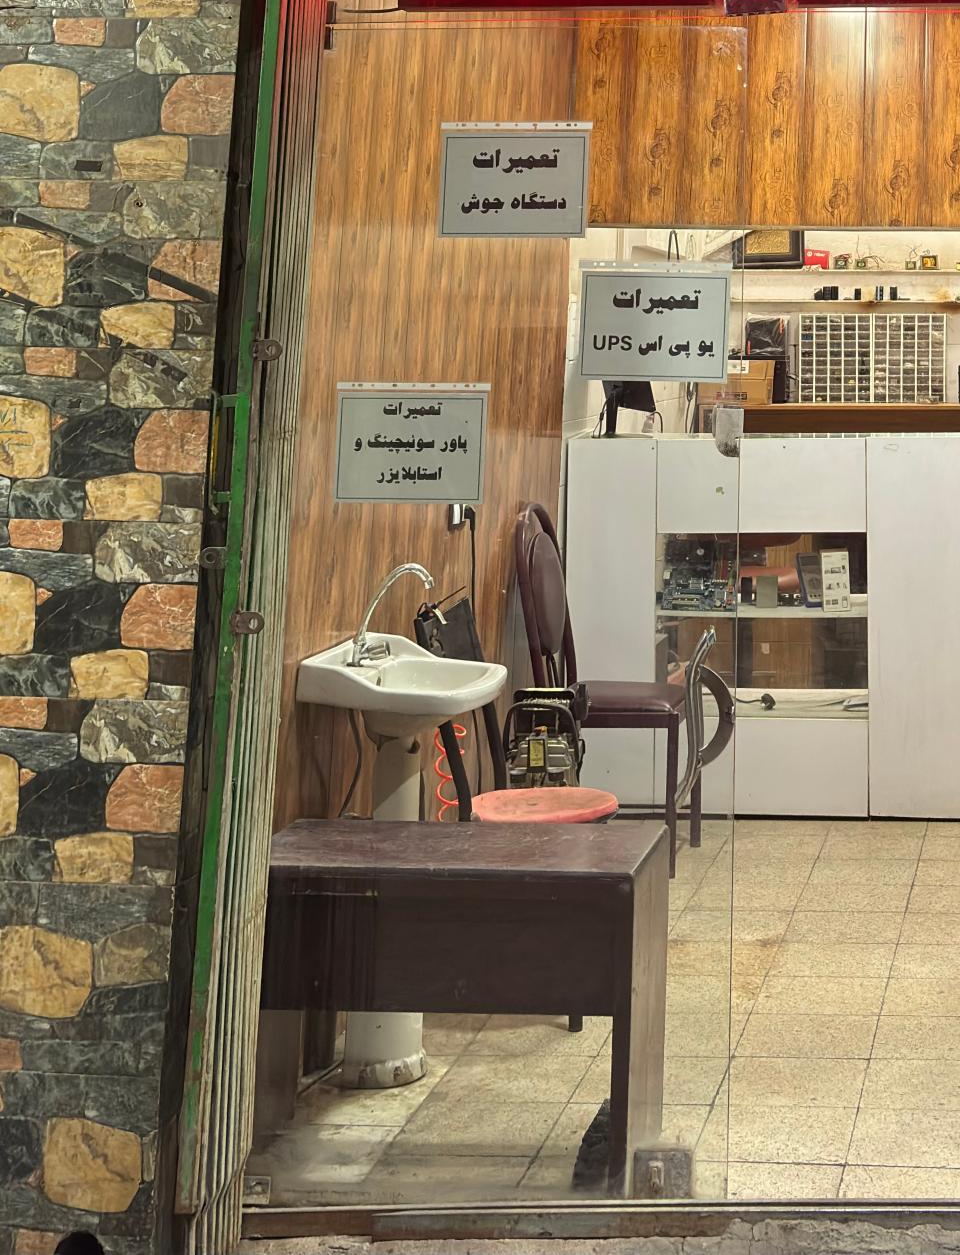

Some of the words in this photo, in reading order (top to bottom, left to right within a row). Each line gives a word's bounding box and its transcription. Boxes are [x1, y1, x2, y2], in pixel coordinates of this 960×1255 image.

[471, 147, 562, 174] تعمیرات
[459, 194, 505, 214] جوش
[510, 192, 568, 211] دستگاه
[611, 287, 702, 315] تعمیرات
[592, 334, 634, 352] UPS
[637, 334, 664, 357] اس
[668, 340, 691, 359] پی
[697, 339, 716, 358] یو
[382, 400, 443, 421] تعمیرات
[353, 436, 364, 454] و
[438, 435, 468, 455] پاور
[375, 465, 443, 485] استابلایزر
